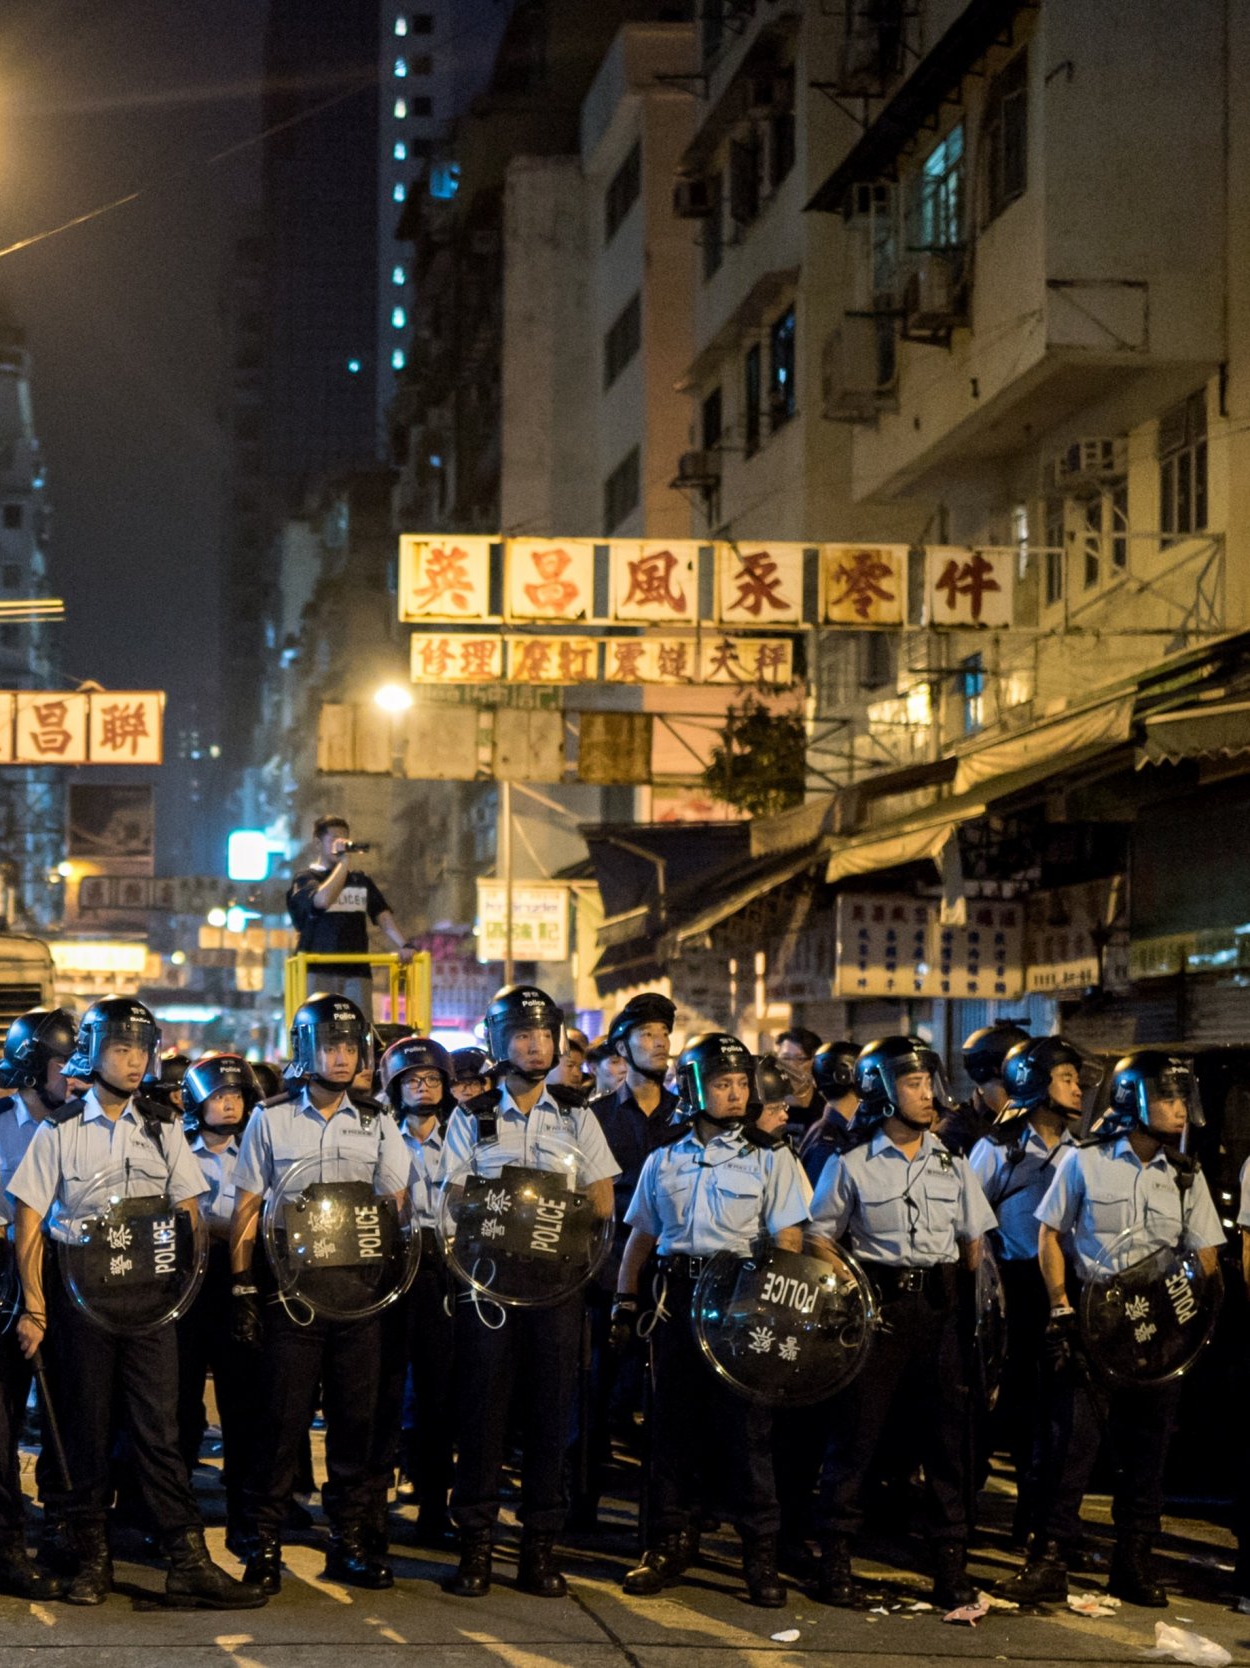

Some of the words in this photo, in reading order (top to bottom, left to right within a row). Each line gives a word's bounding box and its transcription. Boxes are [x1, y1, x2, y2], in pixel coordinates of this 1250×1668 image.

[333, 1011, 356, 1021] Police
[521, 999, 546, 1008] Police
[219, 1065, 241, 1074] Police
[404, 1046, 427, 1055] Police
[720, 1045, 744, 1054] Police
[354, 1206, 383, 1258] POLICE
[480, 1188, 512, 1240] 警察
[530, 1194, 567, 1253] POLICE
[107, 1224, 133, 1276] 警察
[153, 1219, 176, 1274] POLICE
[760, 1272, 819, 1313] POLICE
[1165, 1268, 1198, 1325] POLICE
[1125, 1295, 1157, 1344] 警察
[748, 1326, 801, 1361] 警察
